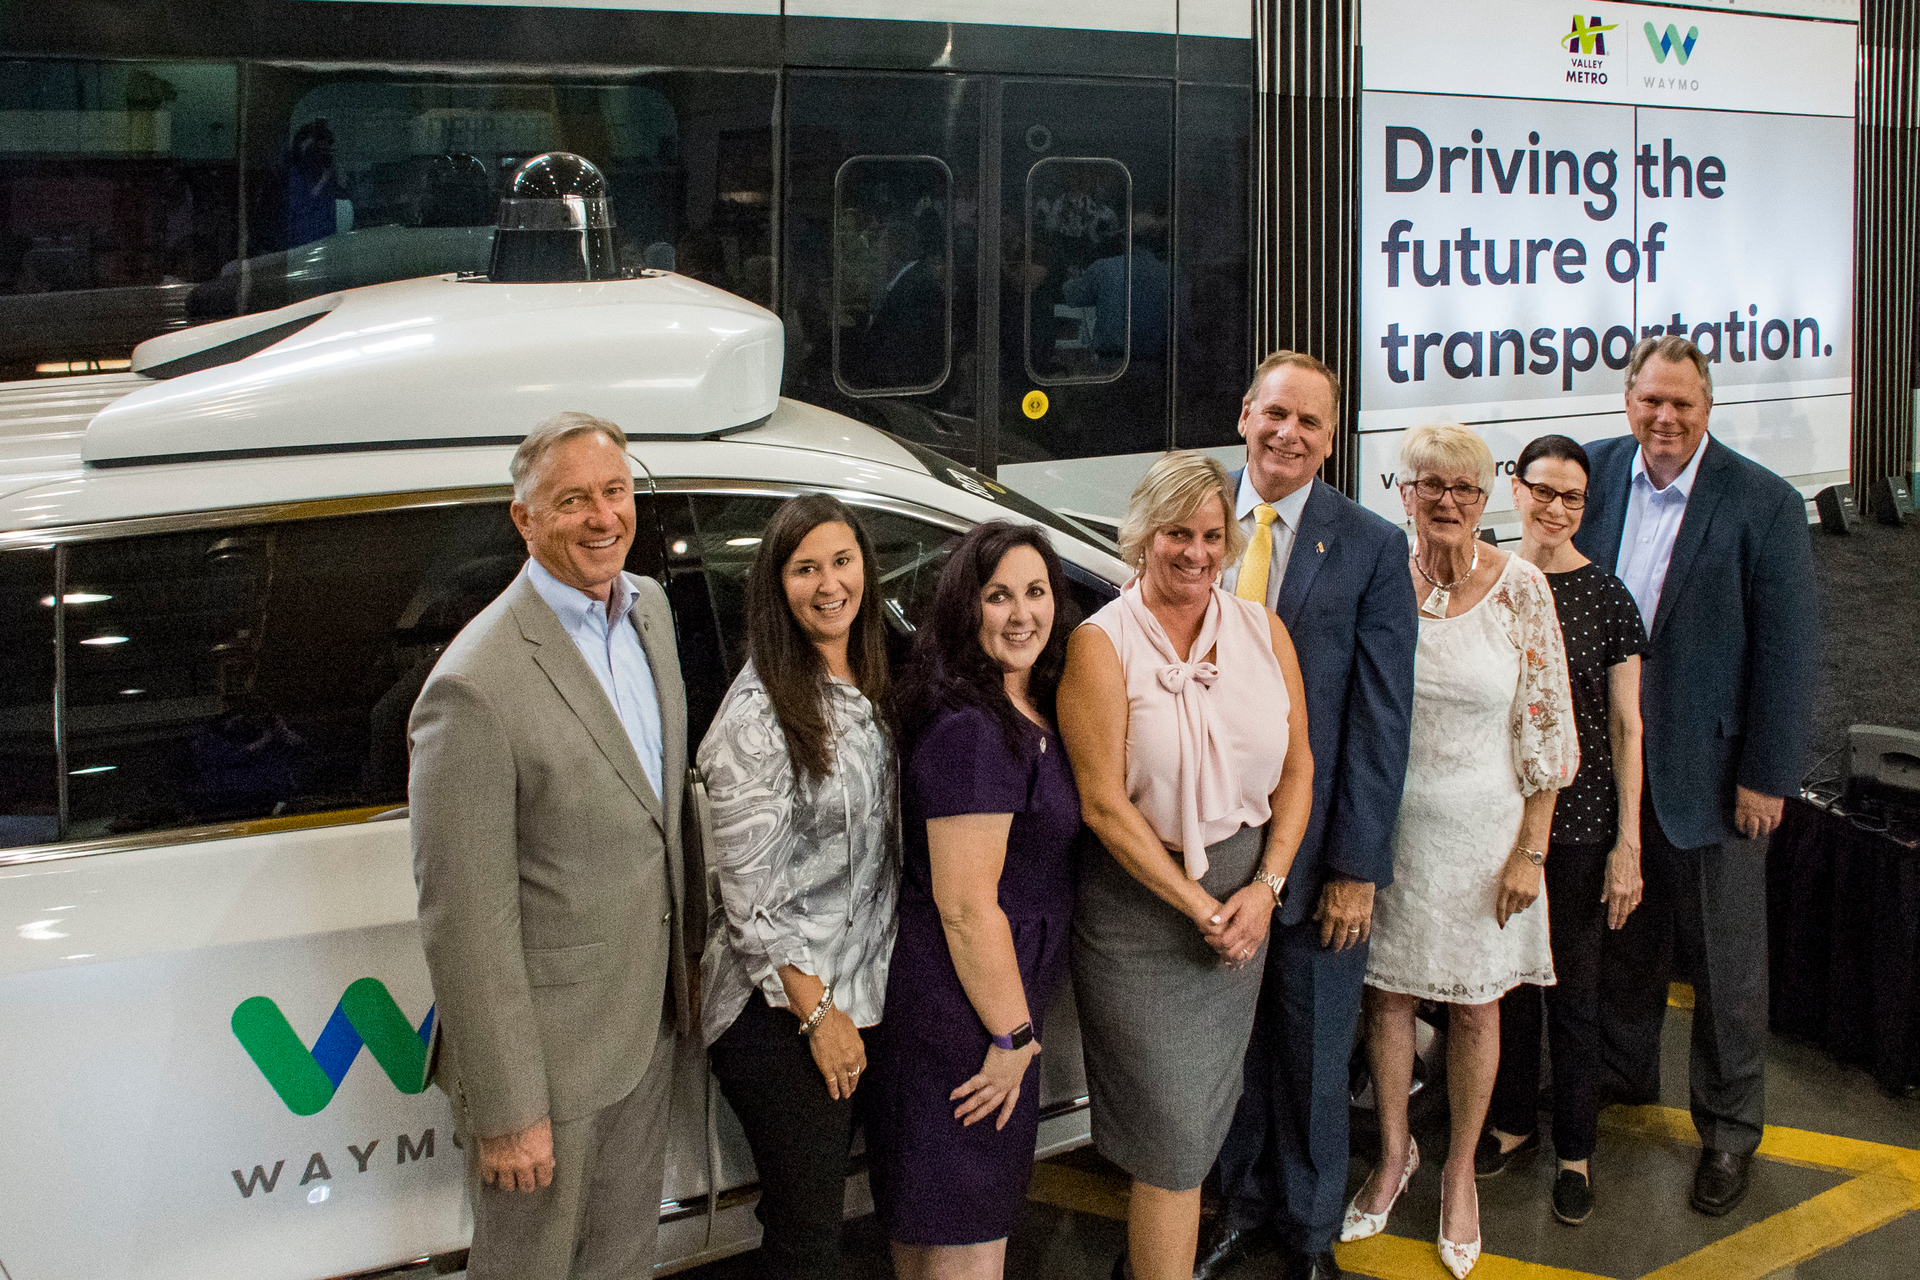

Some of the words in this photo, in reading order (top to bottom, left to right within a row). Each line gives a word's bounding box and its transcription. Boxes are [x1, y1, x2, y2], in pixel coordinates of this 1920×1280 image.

[1565, 70, 1608, 85] METRO
[1571, 58, 1603, 69] VALLEY
[1643, 76, 1699, 92] WAYMO
[1385, 126, 1618, 222] Driving
[1638, 139, 1727, 199] the
[1381, 220, 1588, 288] future
[1605, 221, 1668, 284] of
[231, 1127, 464, 1199] WAYM
